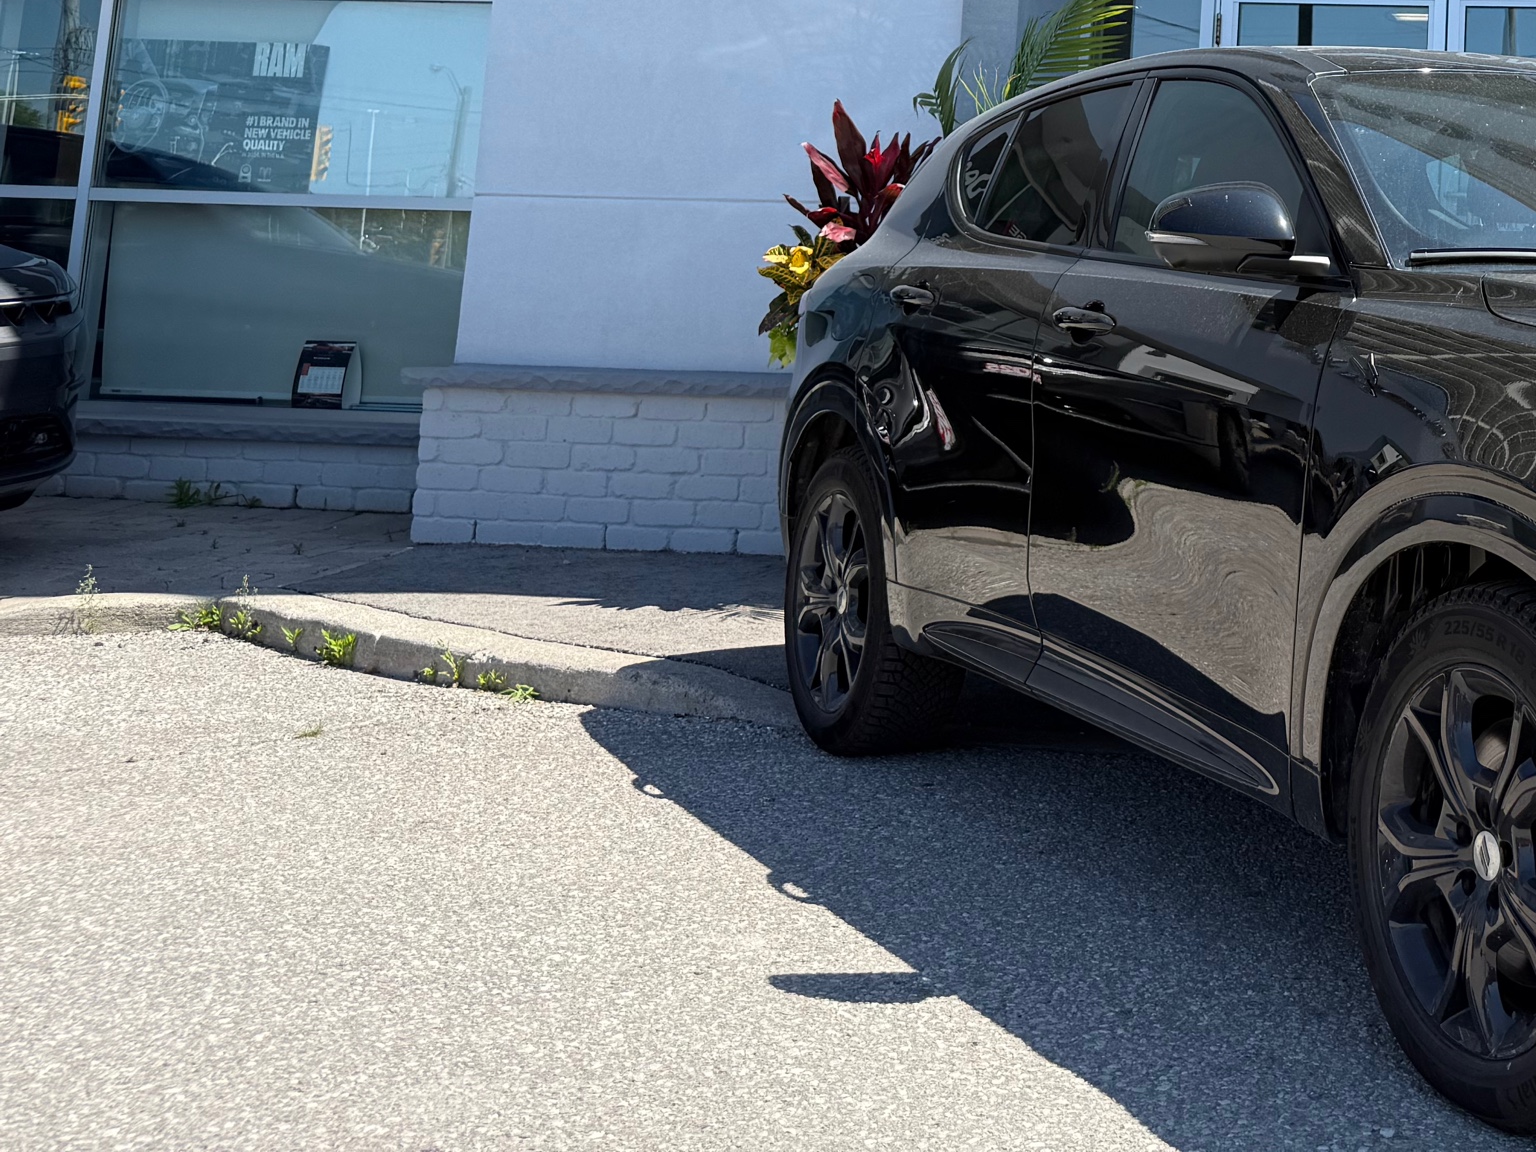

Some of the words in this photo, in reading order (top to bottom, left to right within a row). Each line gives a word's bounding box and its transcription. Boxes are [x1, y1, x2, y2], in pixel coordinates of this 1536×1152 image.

[252, 42, 309, 78] RAM
[245, 115, 259, 127] #1
[259, 116, 297, 128] BRAND
[298, 117, 310, 129] IN
[244, 128, 269, 139] NEW
[270, 128, 312, 140] VEHICLE
[243, 139, 286, 151] QUALITY
[1444, 619, 1495, 642] 225/55
